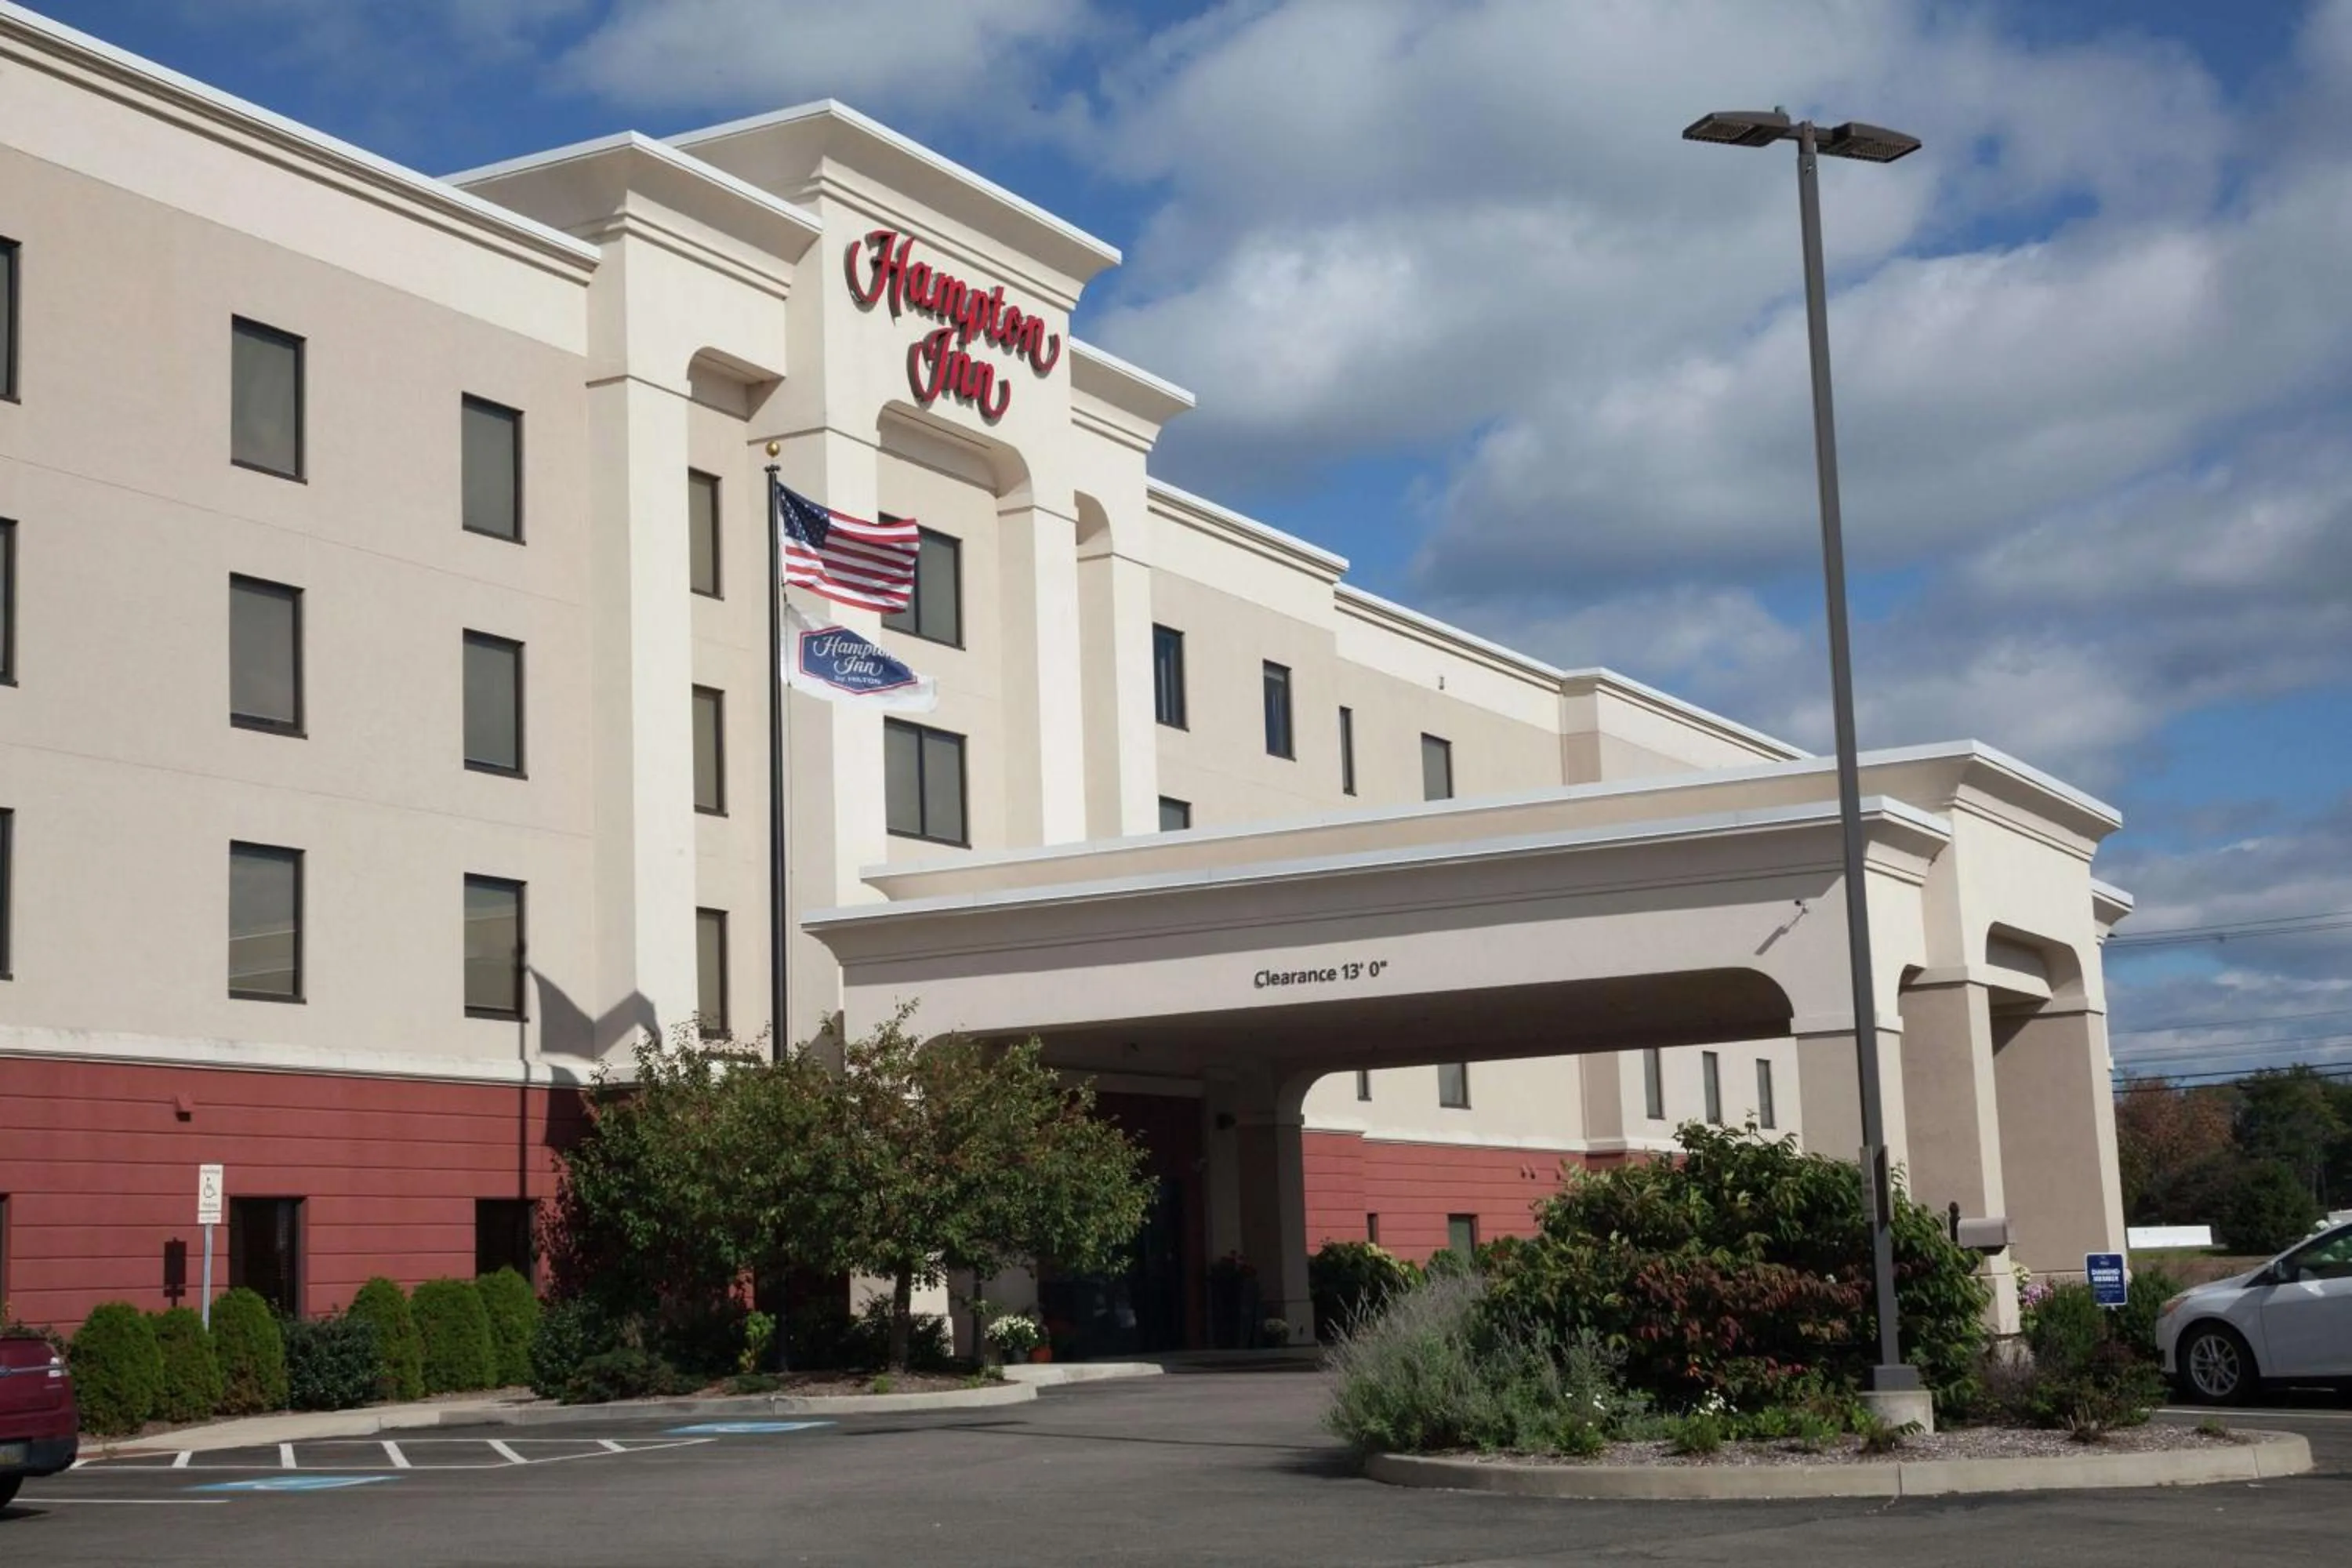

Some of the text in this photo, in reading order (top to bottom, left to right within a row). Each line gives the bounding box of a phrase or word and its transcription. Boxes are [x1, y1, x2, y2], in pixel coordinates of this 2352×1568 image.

[845, 230, 1061, 374] Hampton
[908, 327, 1011, 421] Inn
[833, 655, 884, 676] Inn
[1254, 969, 1337, 988] Clearance
[1341, 962, 1363, 980] 13'
